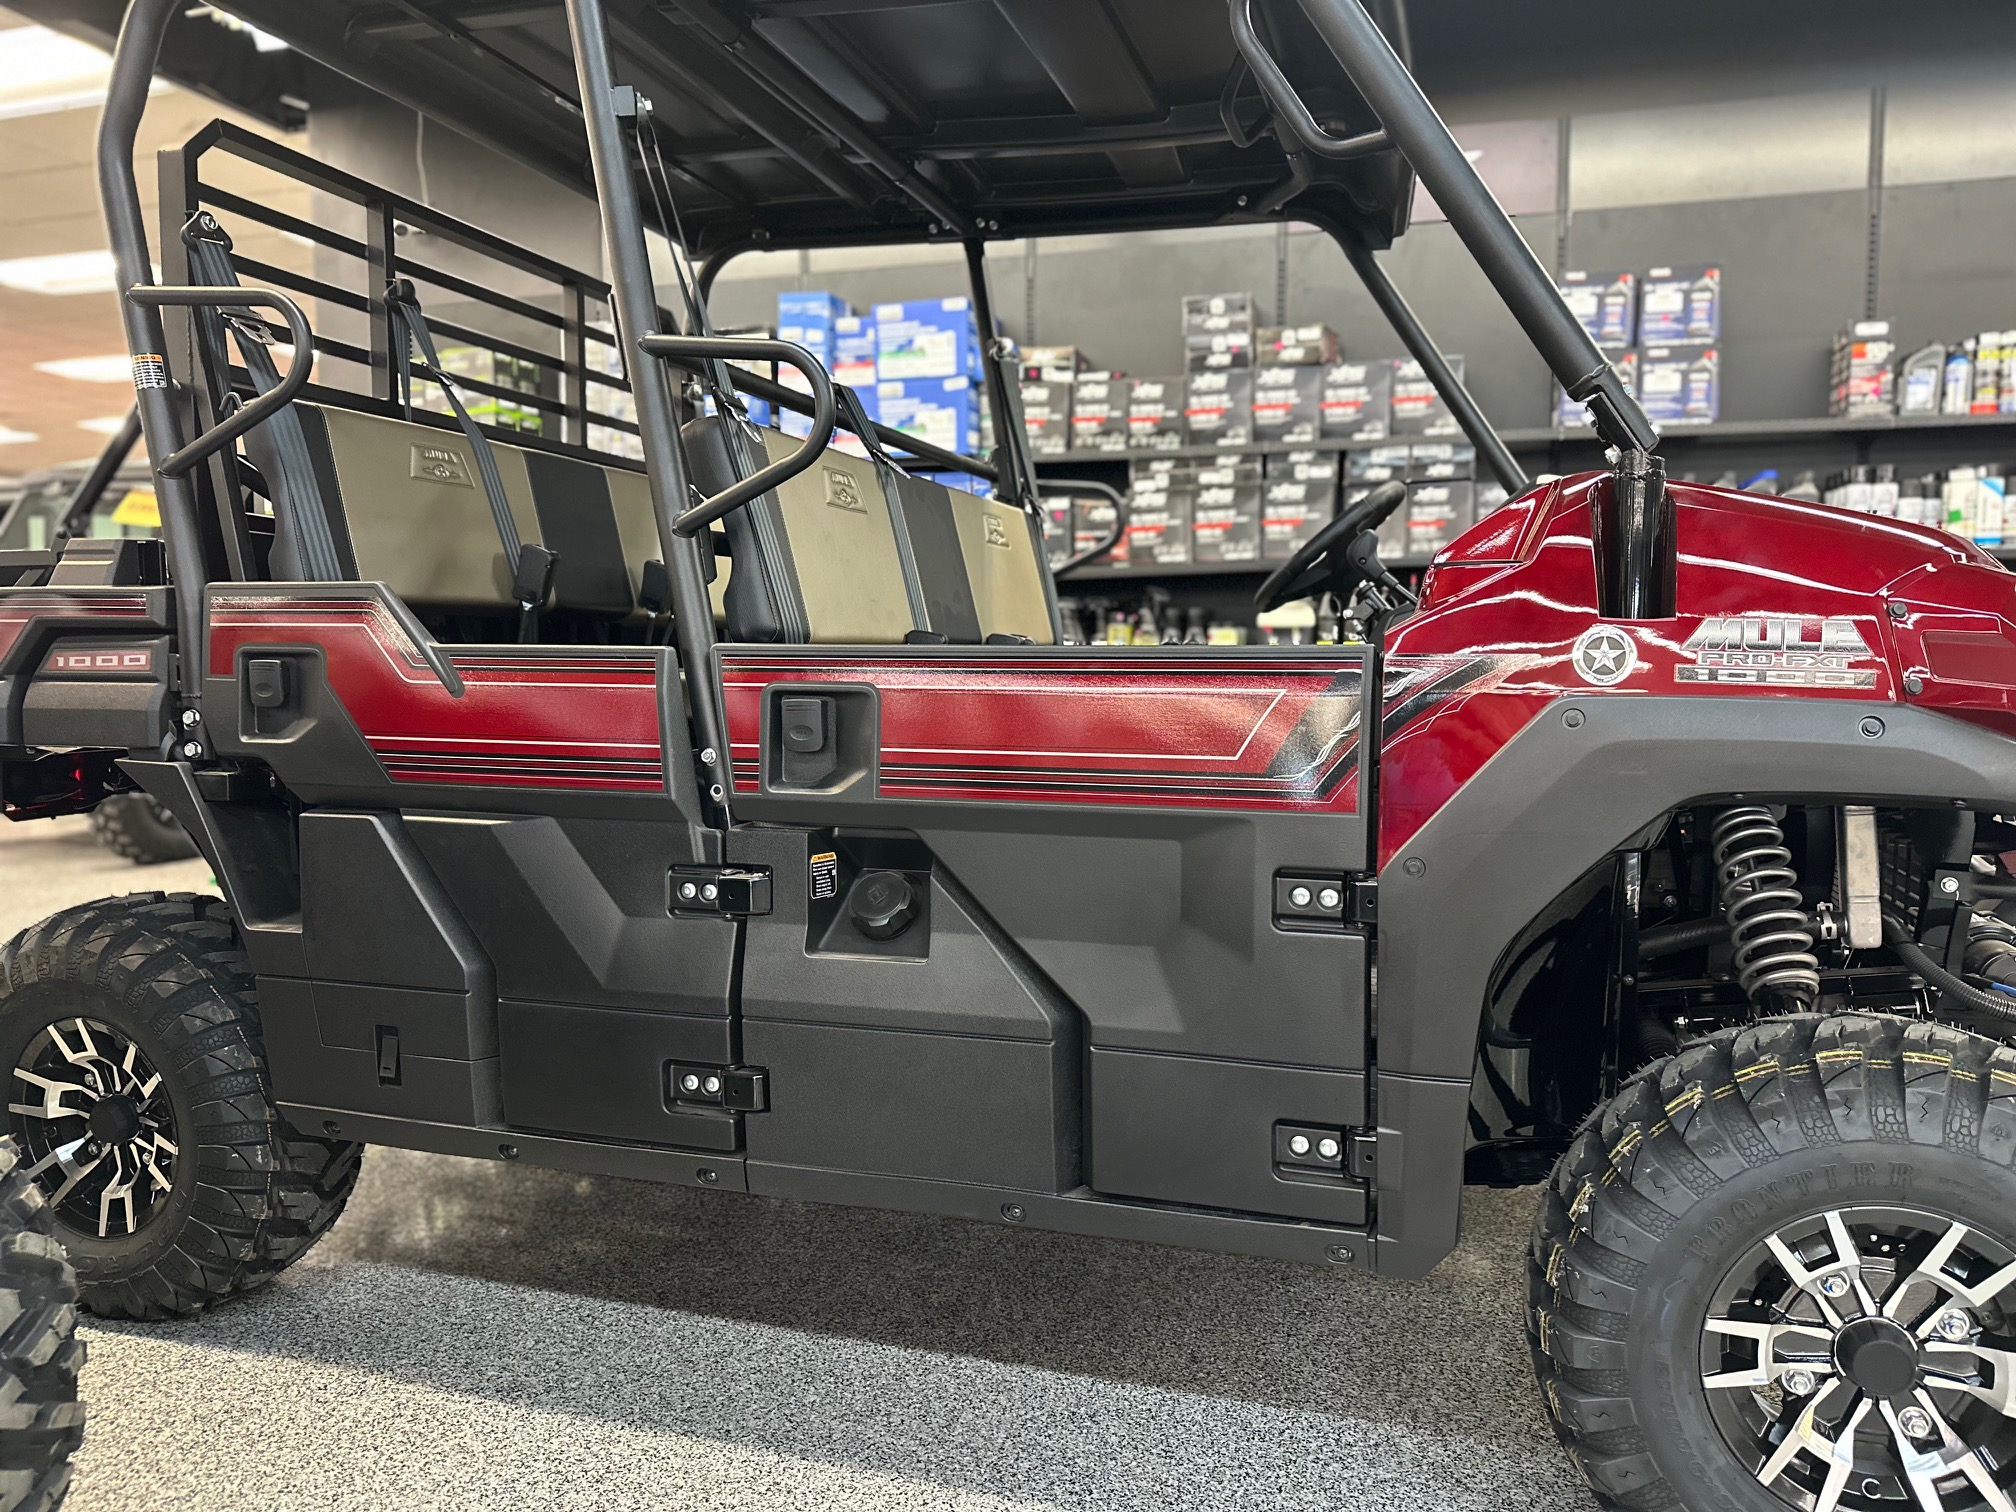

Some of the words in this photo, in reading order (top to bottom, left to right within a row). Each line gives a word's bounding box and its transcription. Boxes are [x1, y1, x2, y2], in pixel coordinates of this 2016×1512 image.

[1680, 617, 1873, 655] MULE
[56, 654, 147, 668] 1000
[1699, 651, 1854, 668] PRO-FXT
[1697, 667, 1856, 686] 1000
